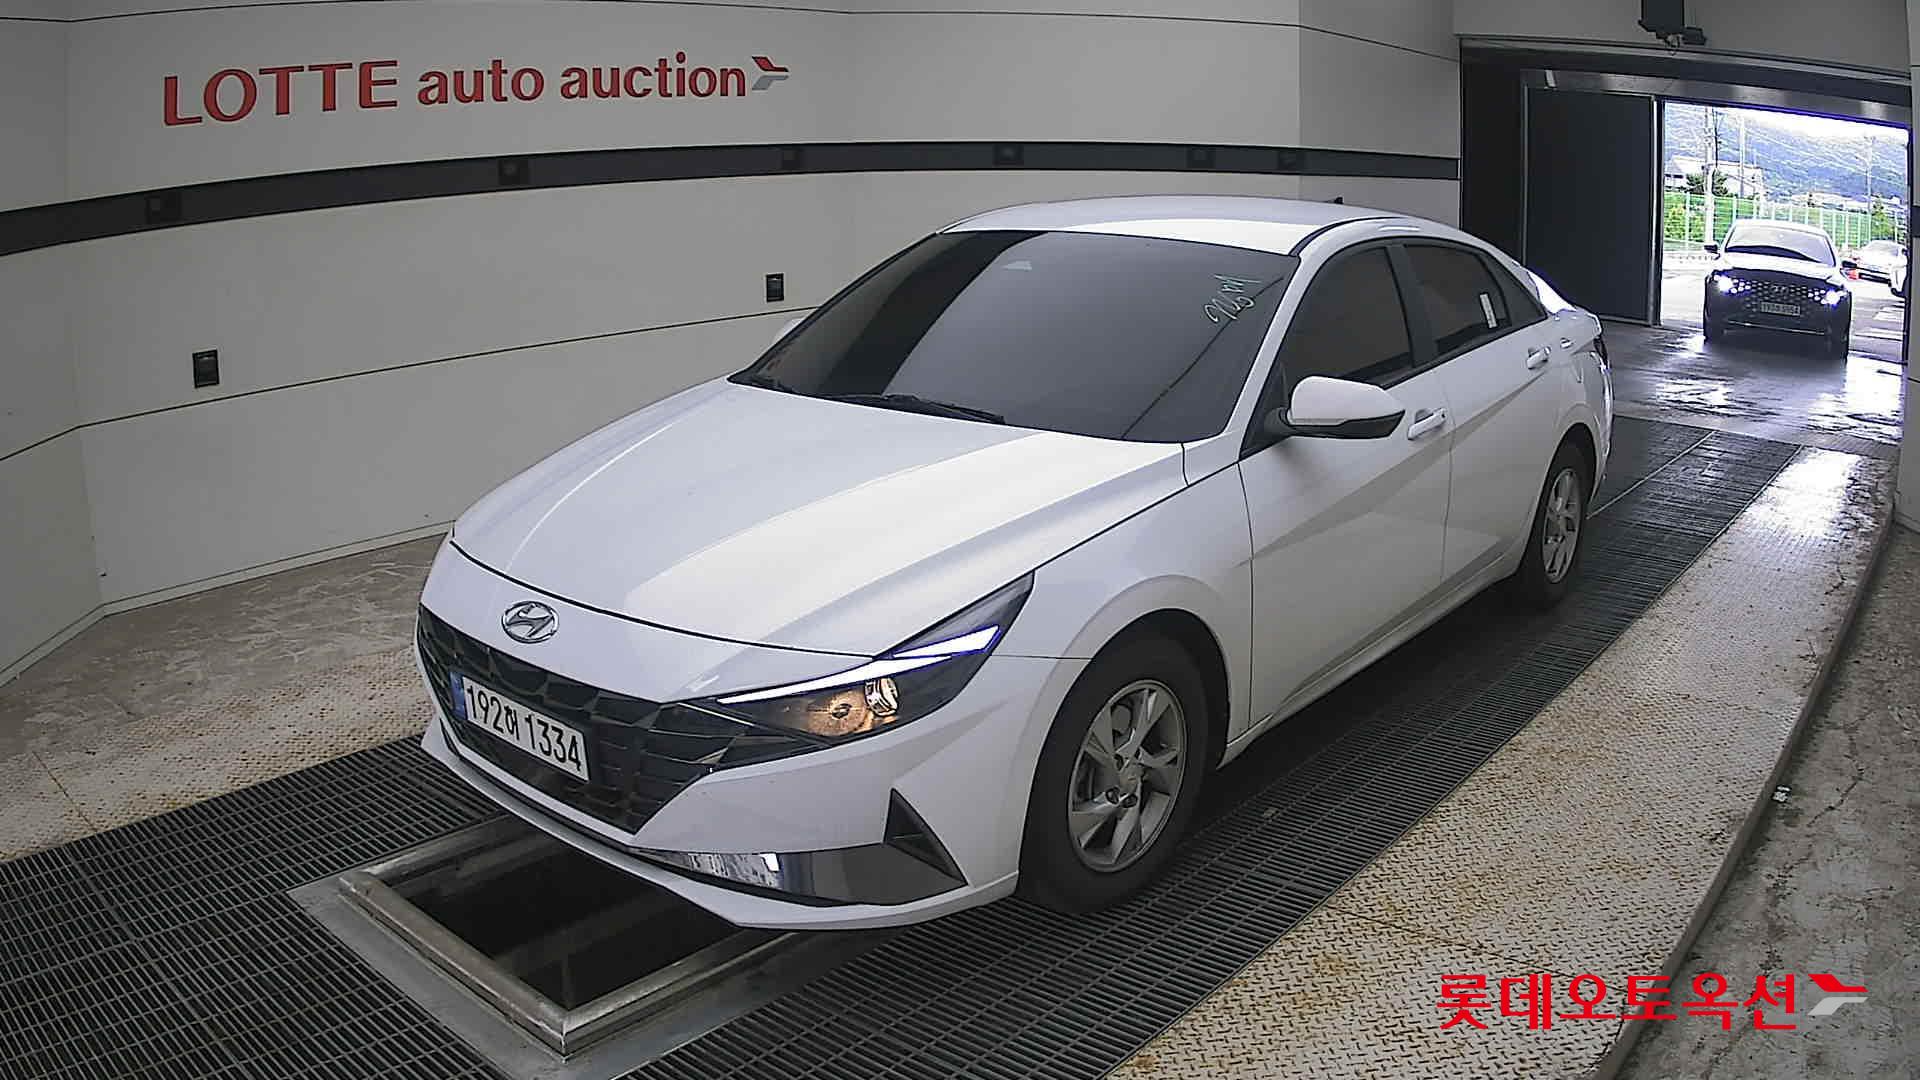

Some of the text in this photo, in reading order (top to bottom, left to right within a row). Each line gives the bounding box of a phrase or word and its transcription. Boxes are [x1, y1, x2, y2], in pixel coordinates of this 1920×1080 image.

[163, 51, 746, 126] LOTTE auto auction
[524, 713, 582, 772] 1334
